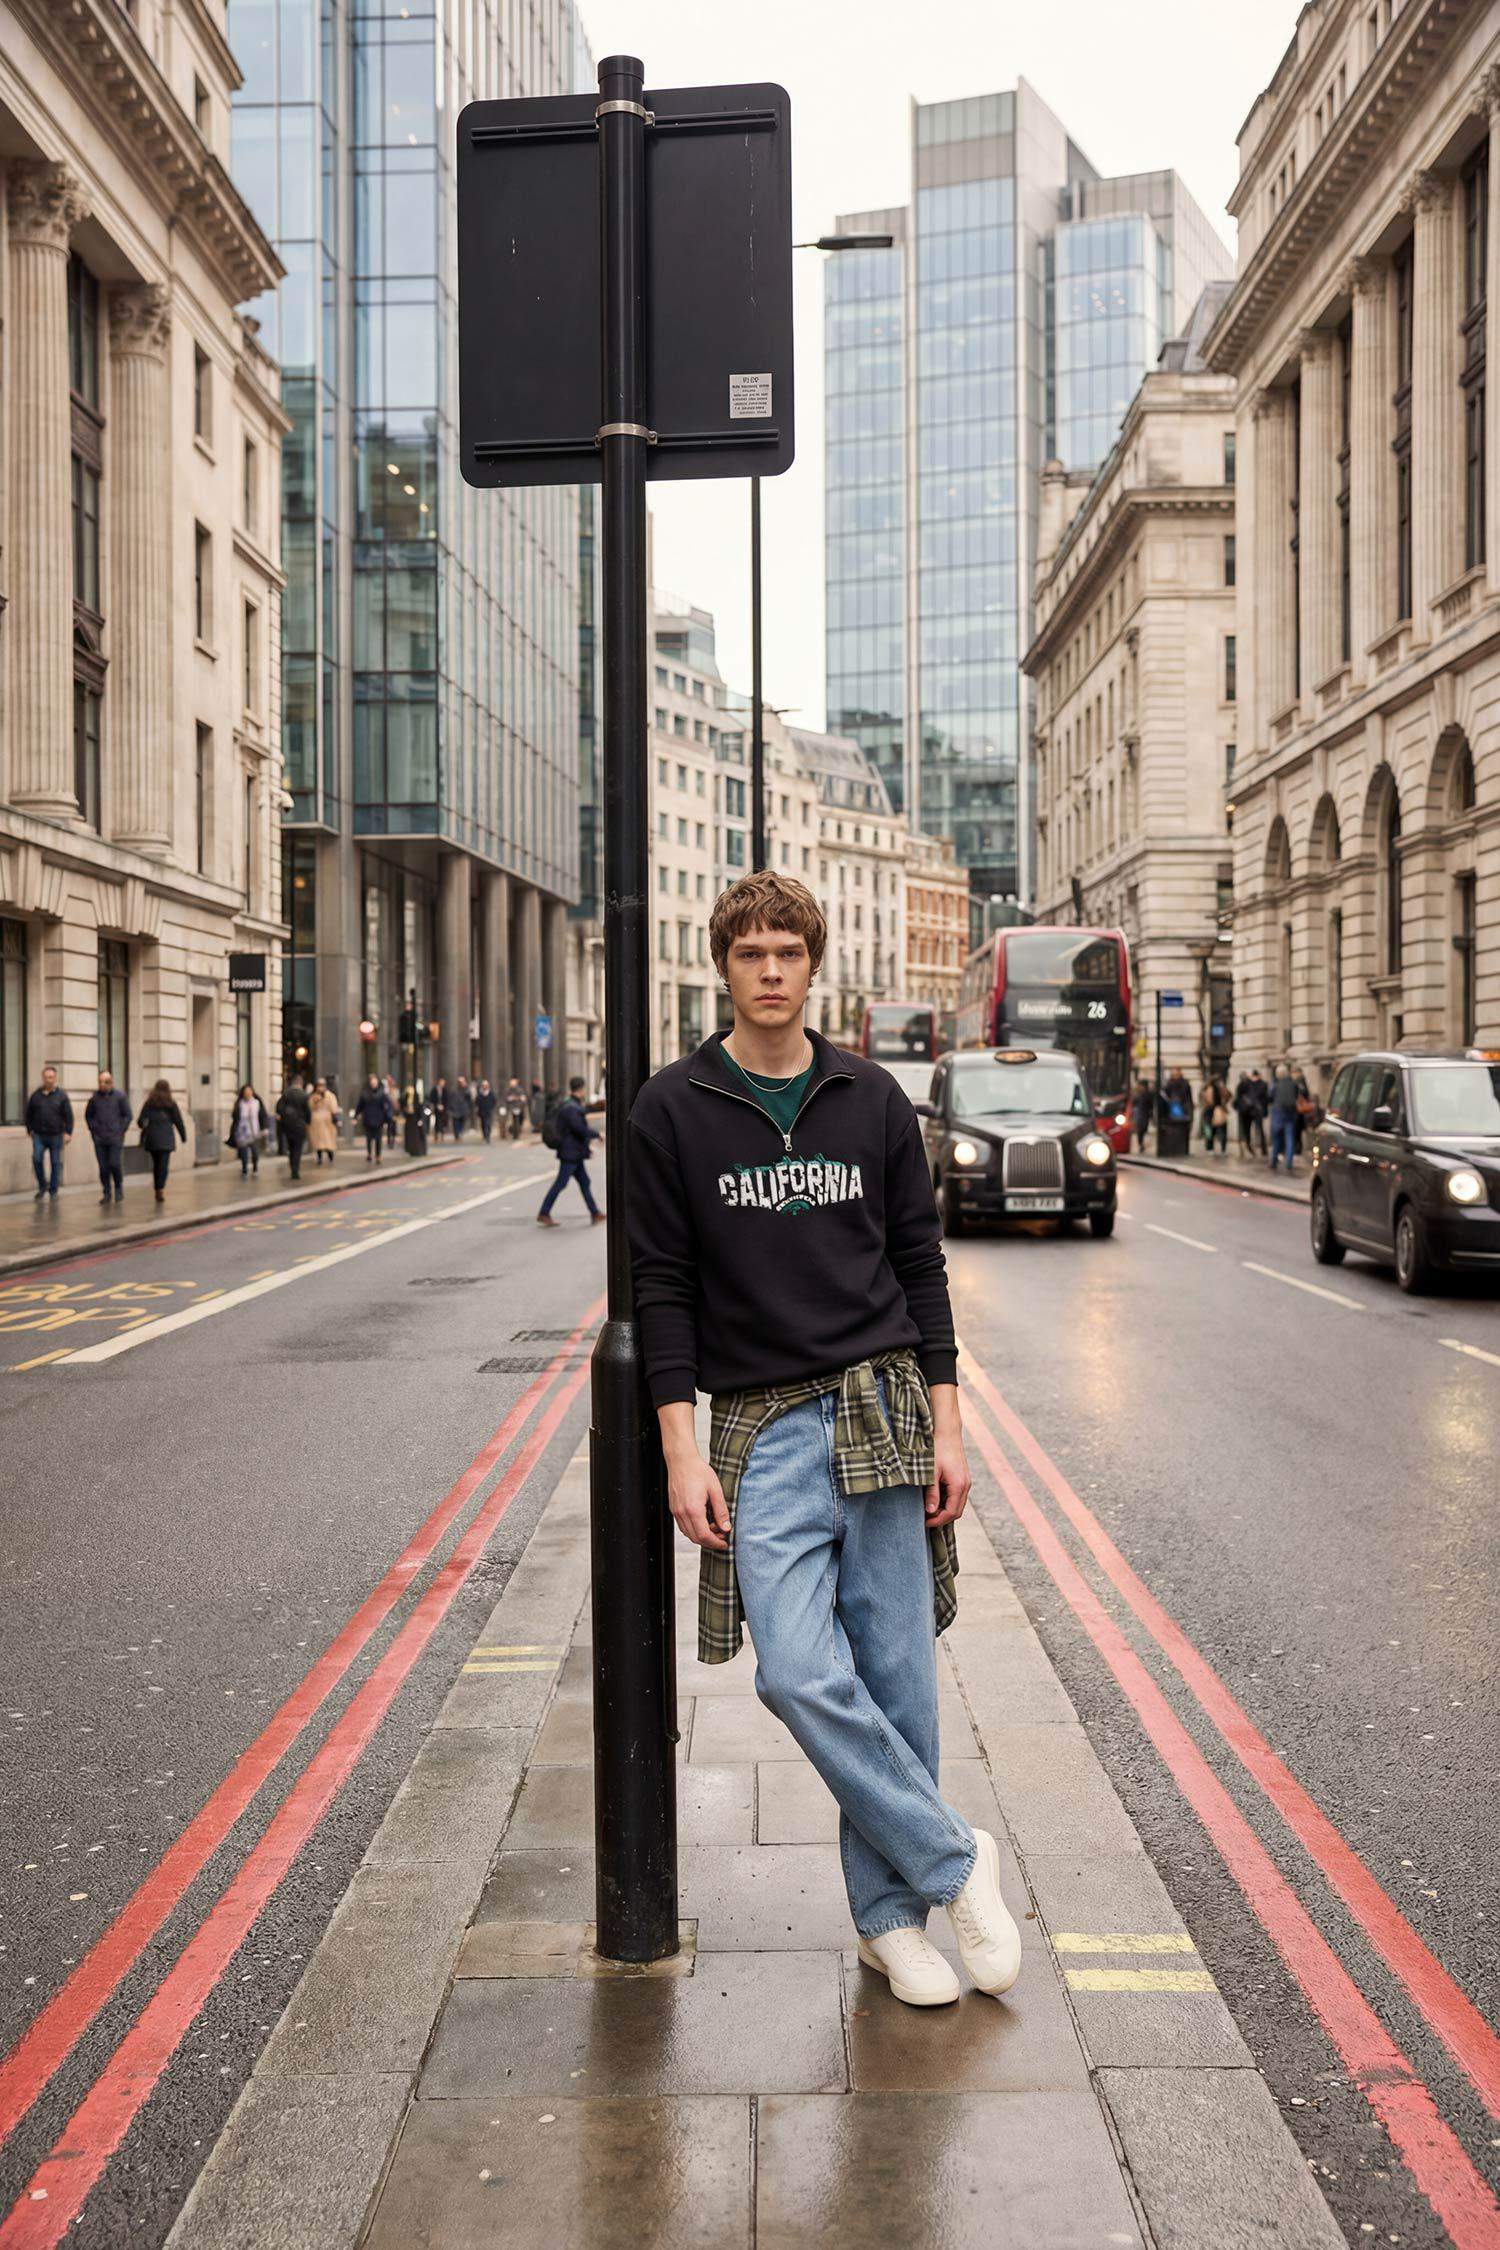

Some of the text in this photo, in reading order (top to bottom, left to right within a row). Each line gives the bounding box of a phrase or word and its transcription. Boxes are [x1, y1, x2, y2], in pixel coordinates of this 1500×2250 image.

[1087, 1000, 1107, 1019] 26
[718, 1160, 864, 1210] CALIFORNIA
[0, 1278, 198, 1304] BUS
[0, 1307, 147, 1332] OP
